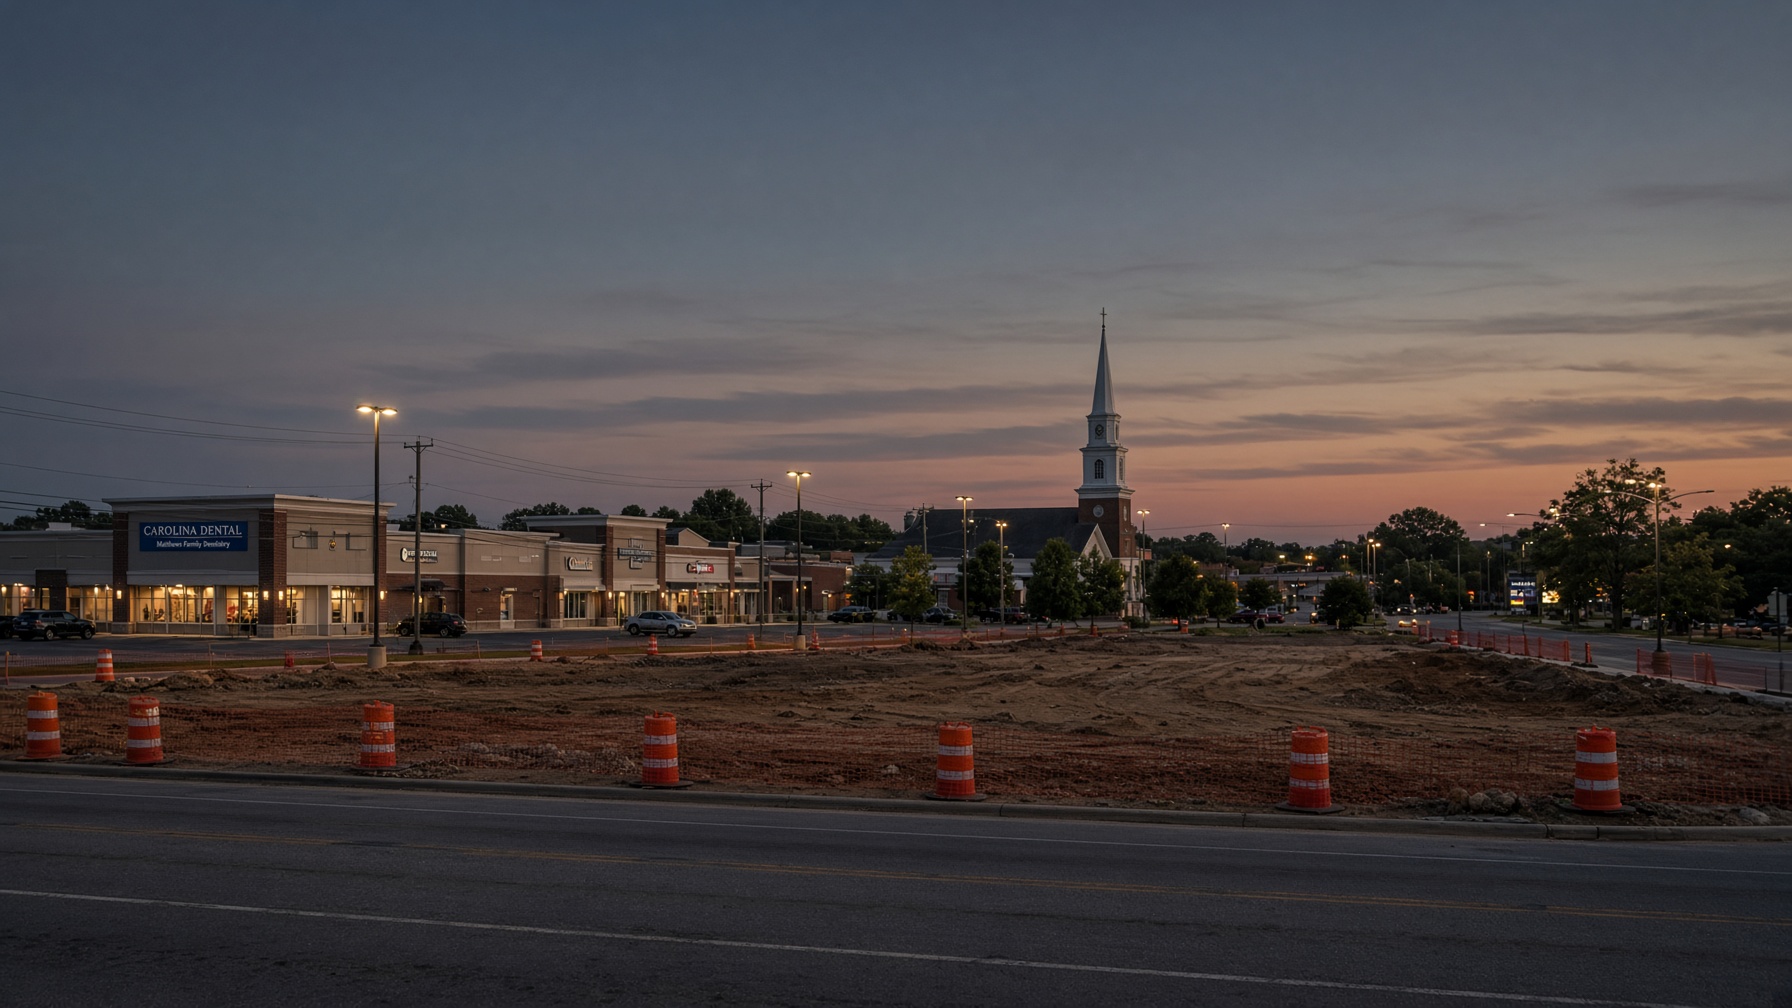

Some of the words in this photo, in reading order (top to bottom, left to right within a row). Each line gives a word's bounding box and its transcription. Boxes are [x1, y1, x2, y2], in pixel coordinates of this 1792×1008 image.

[144, 525, 197, 536] CAROLINA
[200, 525, 242, 535] DENTAL
[156, 540, 182, 548] Matthews
[183, 540, 202, 548] Family
